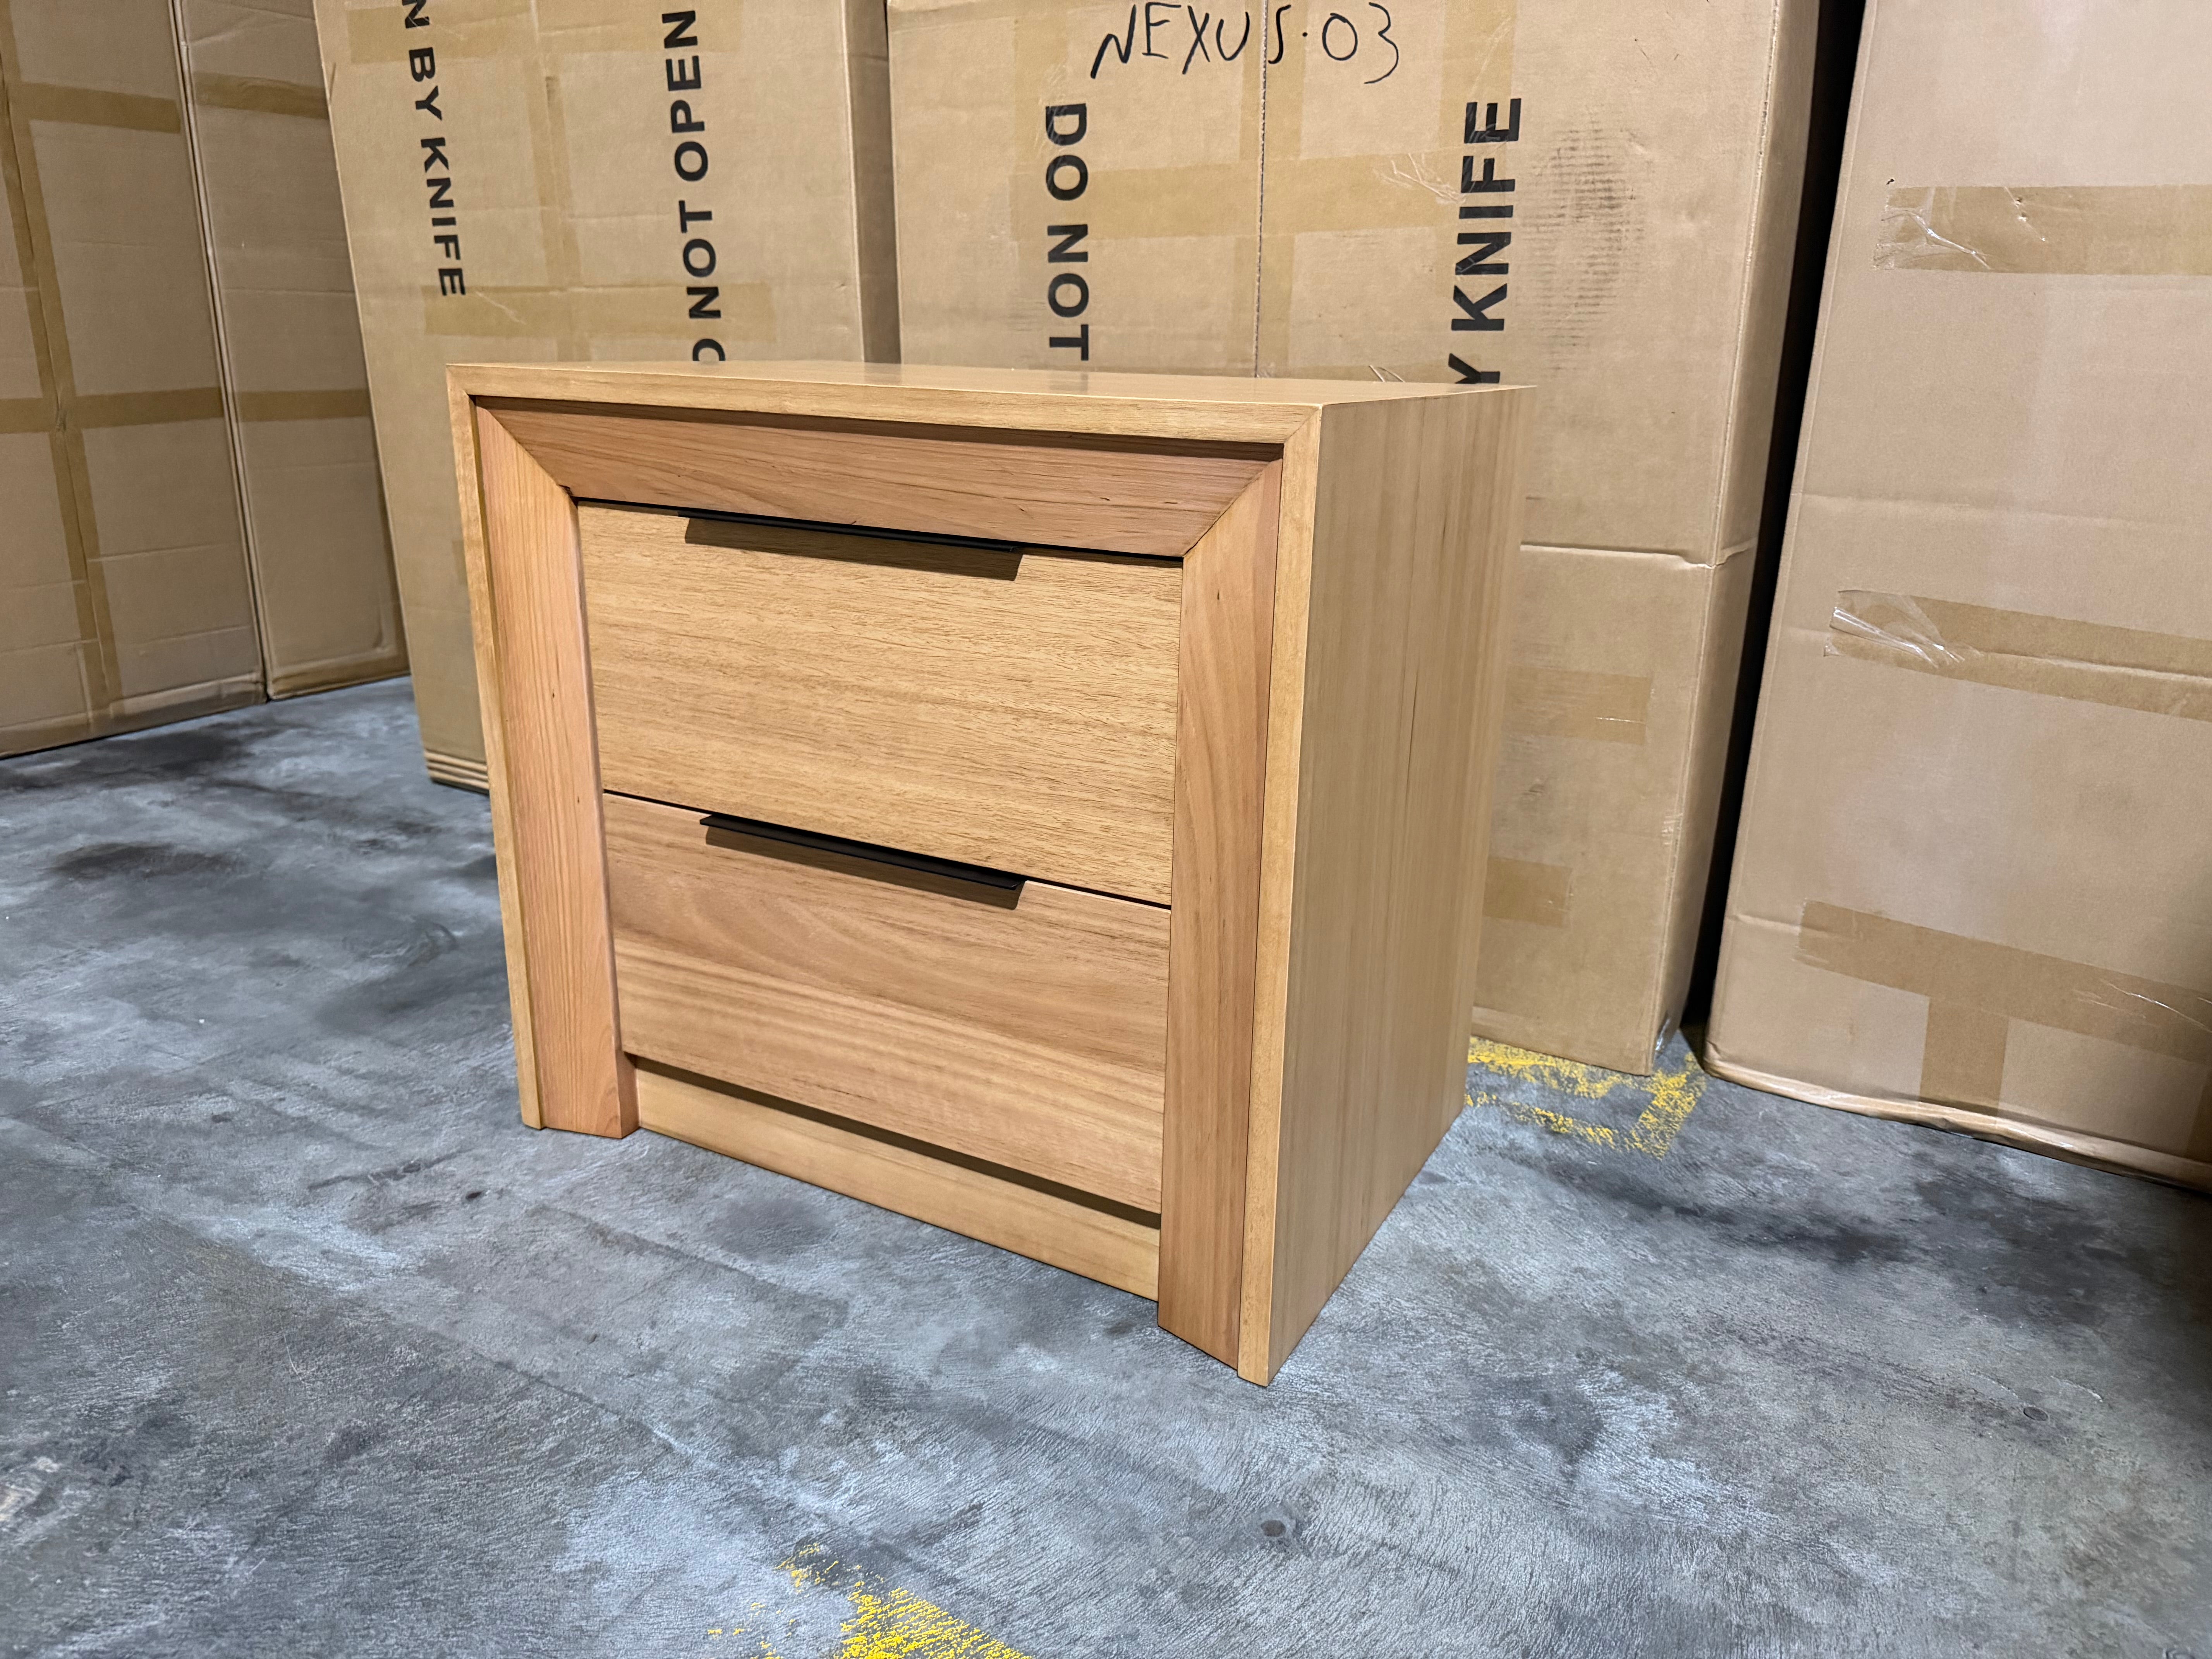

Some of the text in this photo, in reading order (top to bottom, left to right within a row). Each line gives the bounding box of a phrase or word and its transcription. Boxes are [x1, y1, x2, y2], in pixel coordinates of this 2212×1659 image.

[409, 47, 442, 120] BY
[662, 10, 708, 181] OPEN
[421, 137, 466, 296] KNIFE
[678, 200, 721, 319] NOT
[1045, 103, 1089, 361] DO NOT
[1451, 98, 1522, 331] KNIFE
